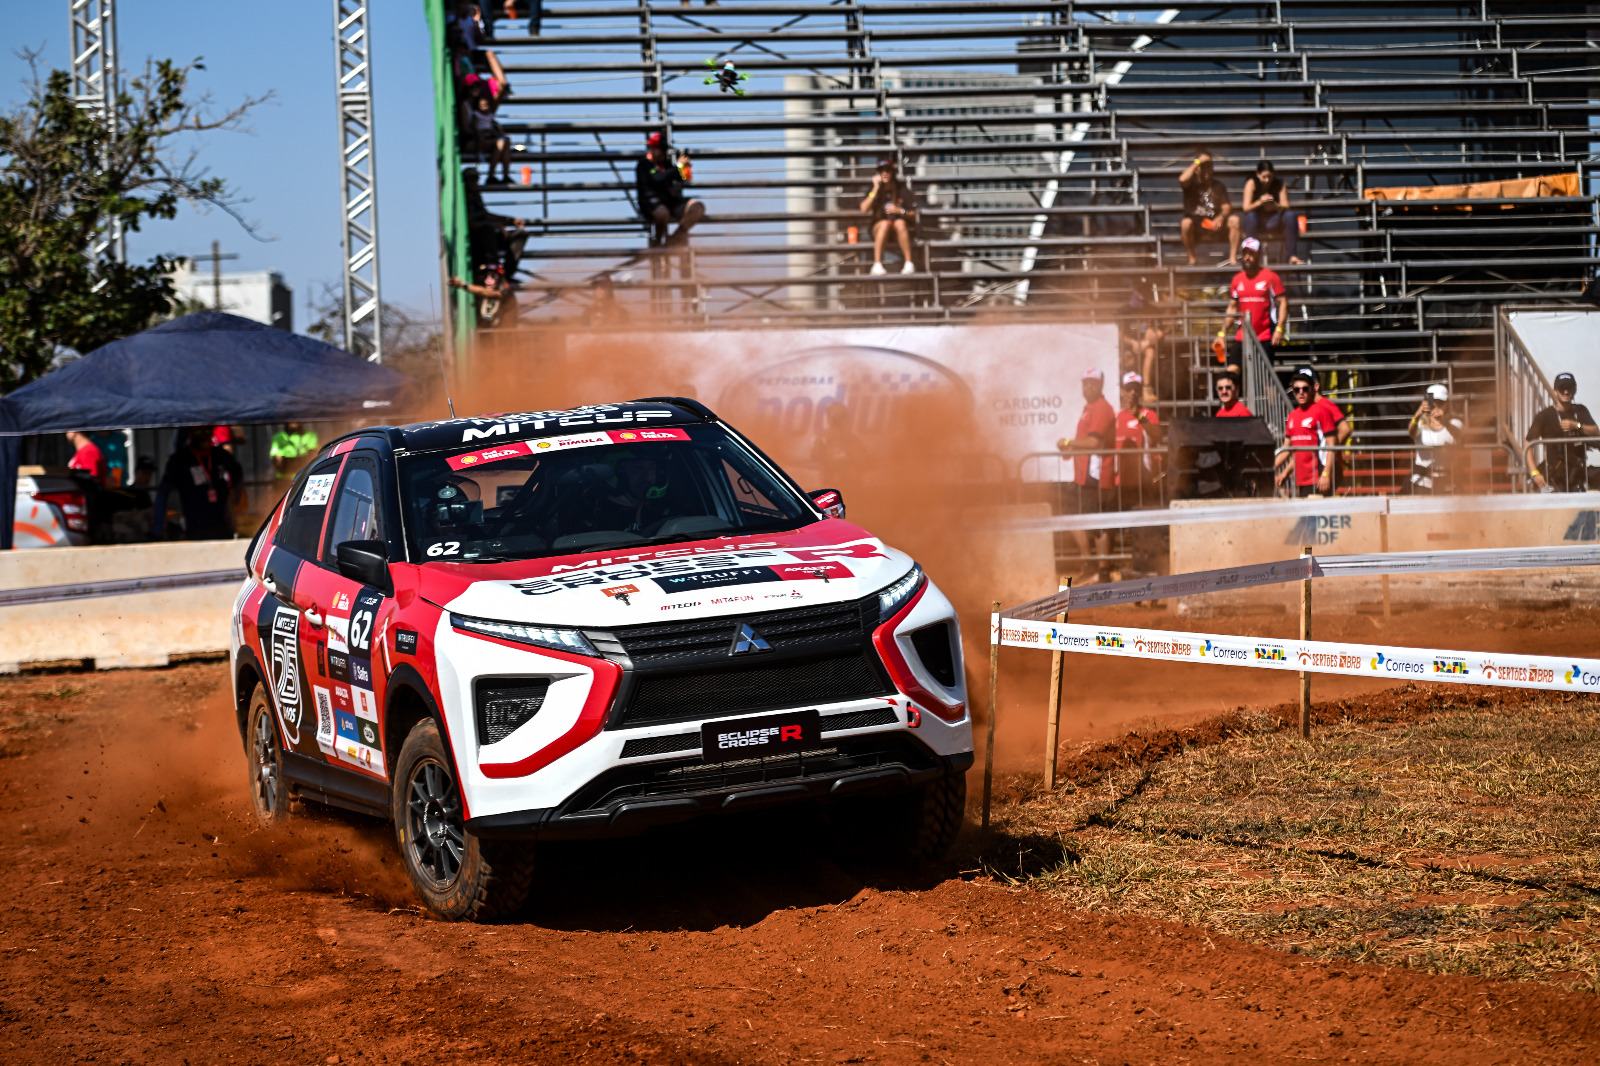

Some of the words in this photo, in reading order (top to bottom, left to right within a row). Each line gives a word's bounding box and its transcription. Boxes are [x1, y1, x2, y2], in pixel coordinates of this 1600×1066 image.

[757, 376, 834, 387] PETROBRAS
[992, 396, 1062, 411] CARBONO
[462, 410, 672, 442] MITCUP
[999, 412, 1058, 427] NEUTRO
[559, 437, 604, 446] RIMULA
[1317, 515, 1352, 529] DER
[1317, 531, 1339, 545] DF
[426, 541, 460, 557] 62
[550, 541, 777, 573] MITCUP
[509, 551, 777, 589] ECLIPSE
[520, 562, 739, 596] CROSS
[350, 609, 373, 650] 62
[1058, 634, 1089, 647] Correios
[1095, 635, 1125, 648] BRASIL
[1147, 640, 1171, 655] SERTÕES
[1178, 643, 1192, 656] BRB
[1213, 646, 1248, 660] Correios
[1254, 648, 1287, 661] BRASIL
[1312, 653, 1339, 668] SERTÕES
[1346, 655, 1362, 669] BRB
[1385, 658, 1425, 674] Correios
[1433, 660, 1470, 674] BRASIL
[1497, 665, 1528, 682] SERTÕES
[1537, 669, 1554, 683] BRB
[718, 727, 779, 742] ECLIPSE
[780, 724, 803, 742] R
[718, 736, 770, 749] CROSS
